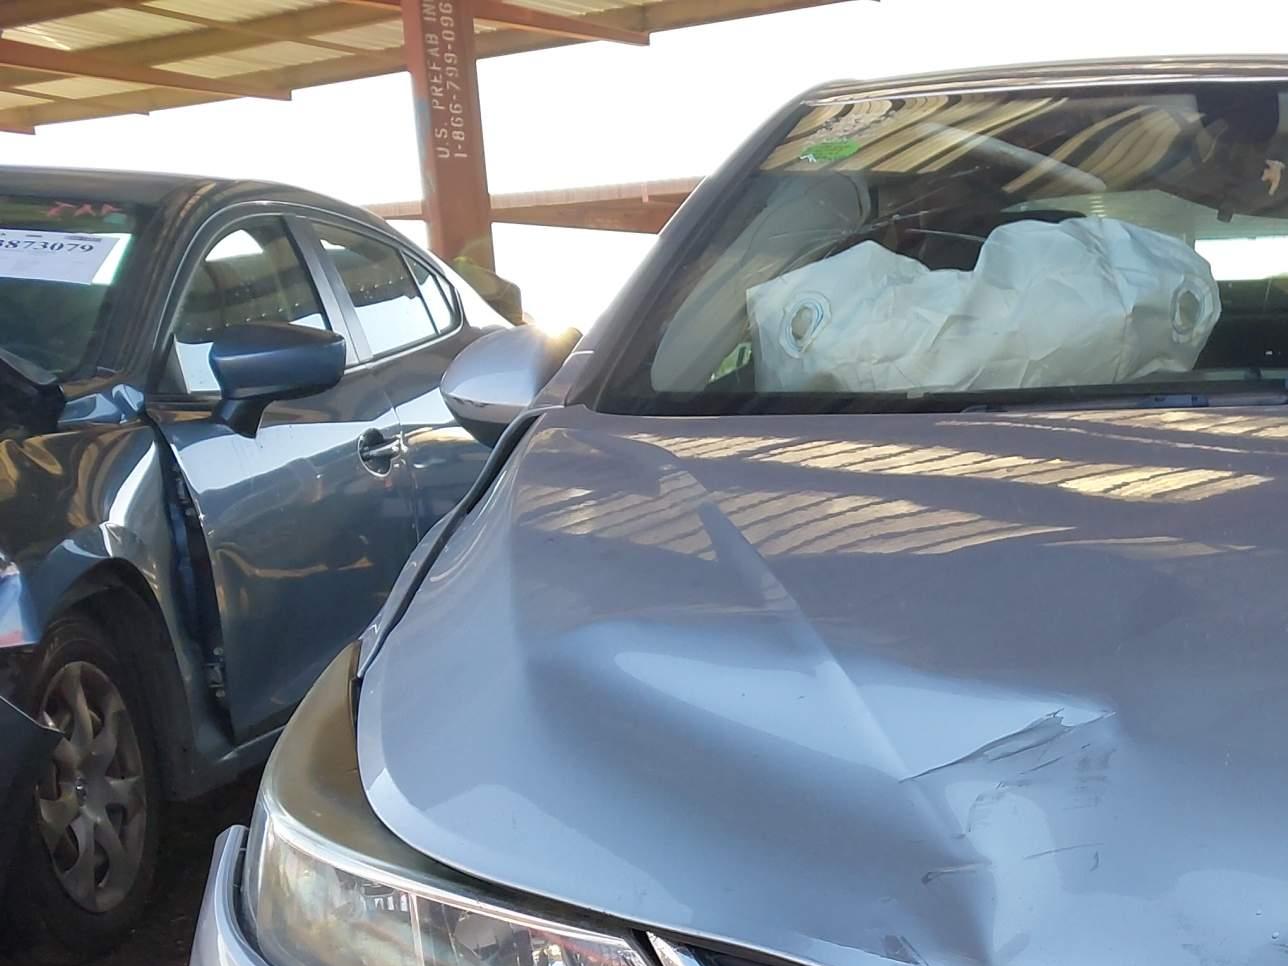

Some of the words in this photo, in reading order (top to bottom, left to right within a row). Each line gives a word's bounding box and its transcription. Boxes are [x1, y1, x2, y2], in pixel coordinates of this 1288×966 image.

[421, 0, 437, 22] IN
[425, 33, 446, 110] PREFAB
[439, 0, 468, 158] 1-866-799-096
[434, 122, 450, 159] U.S.
